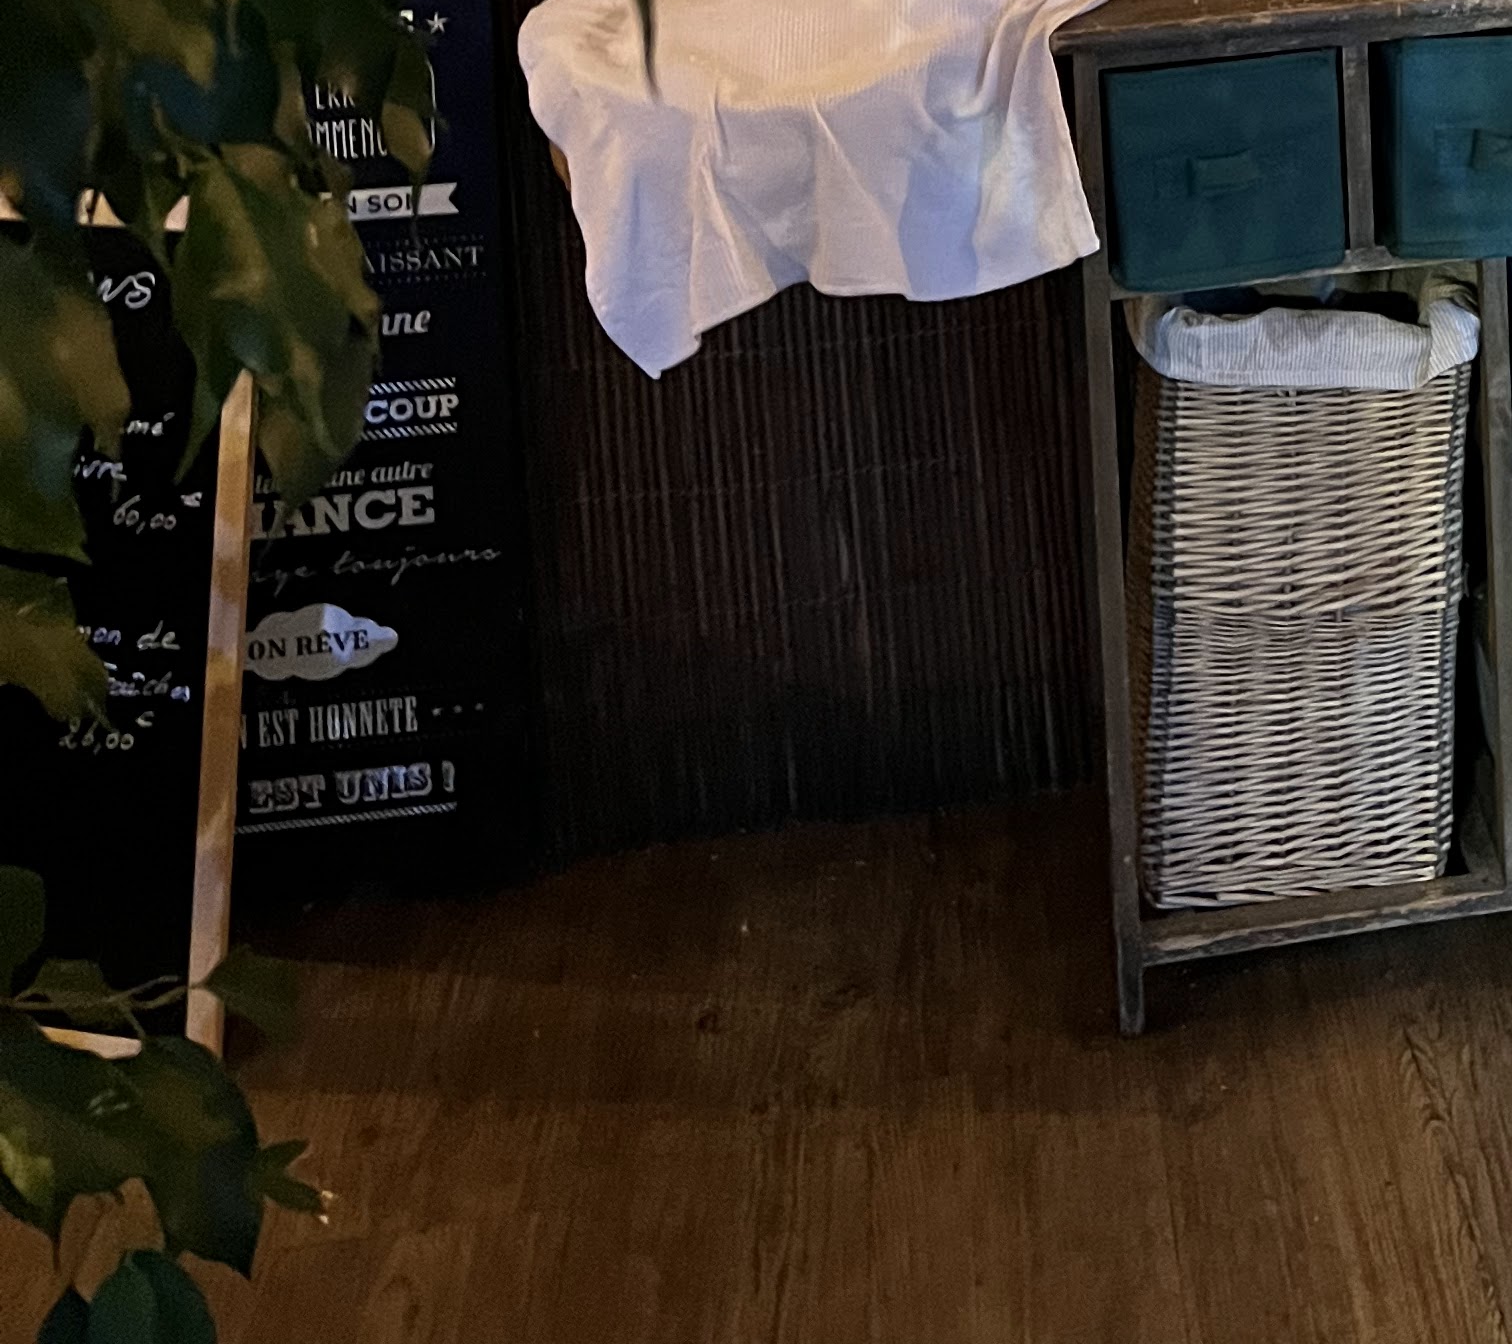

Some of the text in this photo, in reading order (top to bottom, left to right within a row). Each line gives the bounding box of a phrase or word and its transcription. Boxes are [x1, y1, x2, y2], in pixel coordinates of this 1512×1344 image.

[365, 392, 460, 425] COUP
[370, 460, 434, 484] autre
[251, 485, 436, 540] ANCE
[258, 708, 299, 748] EST
[247, 773, 326, 815] EST
[335, 761, 433, 805] UNIS
